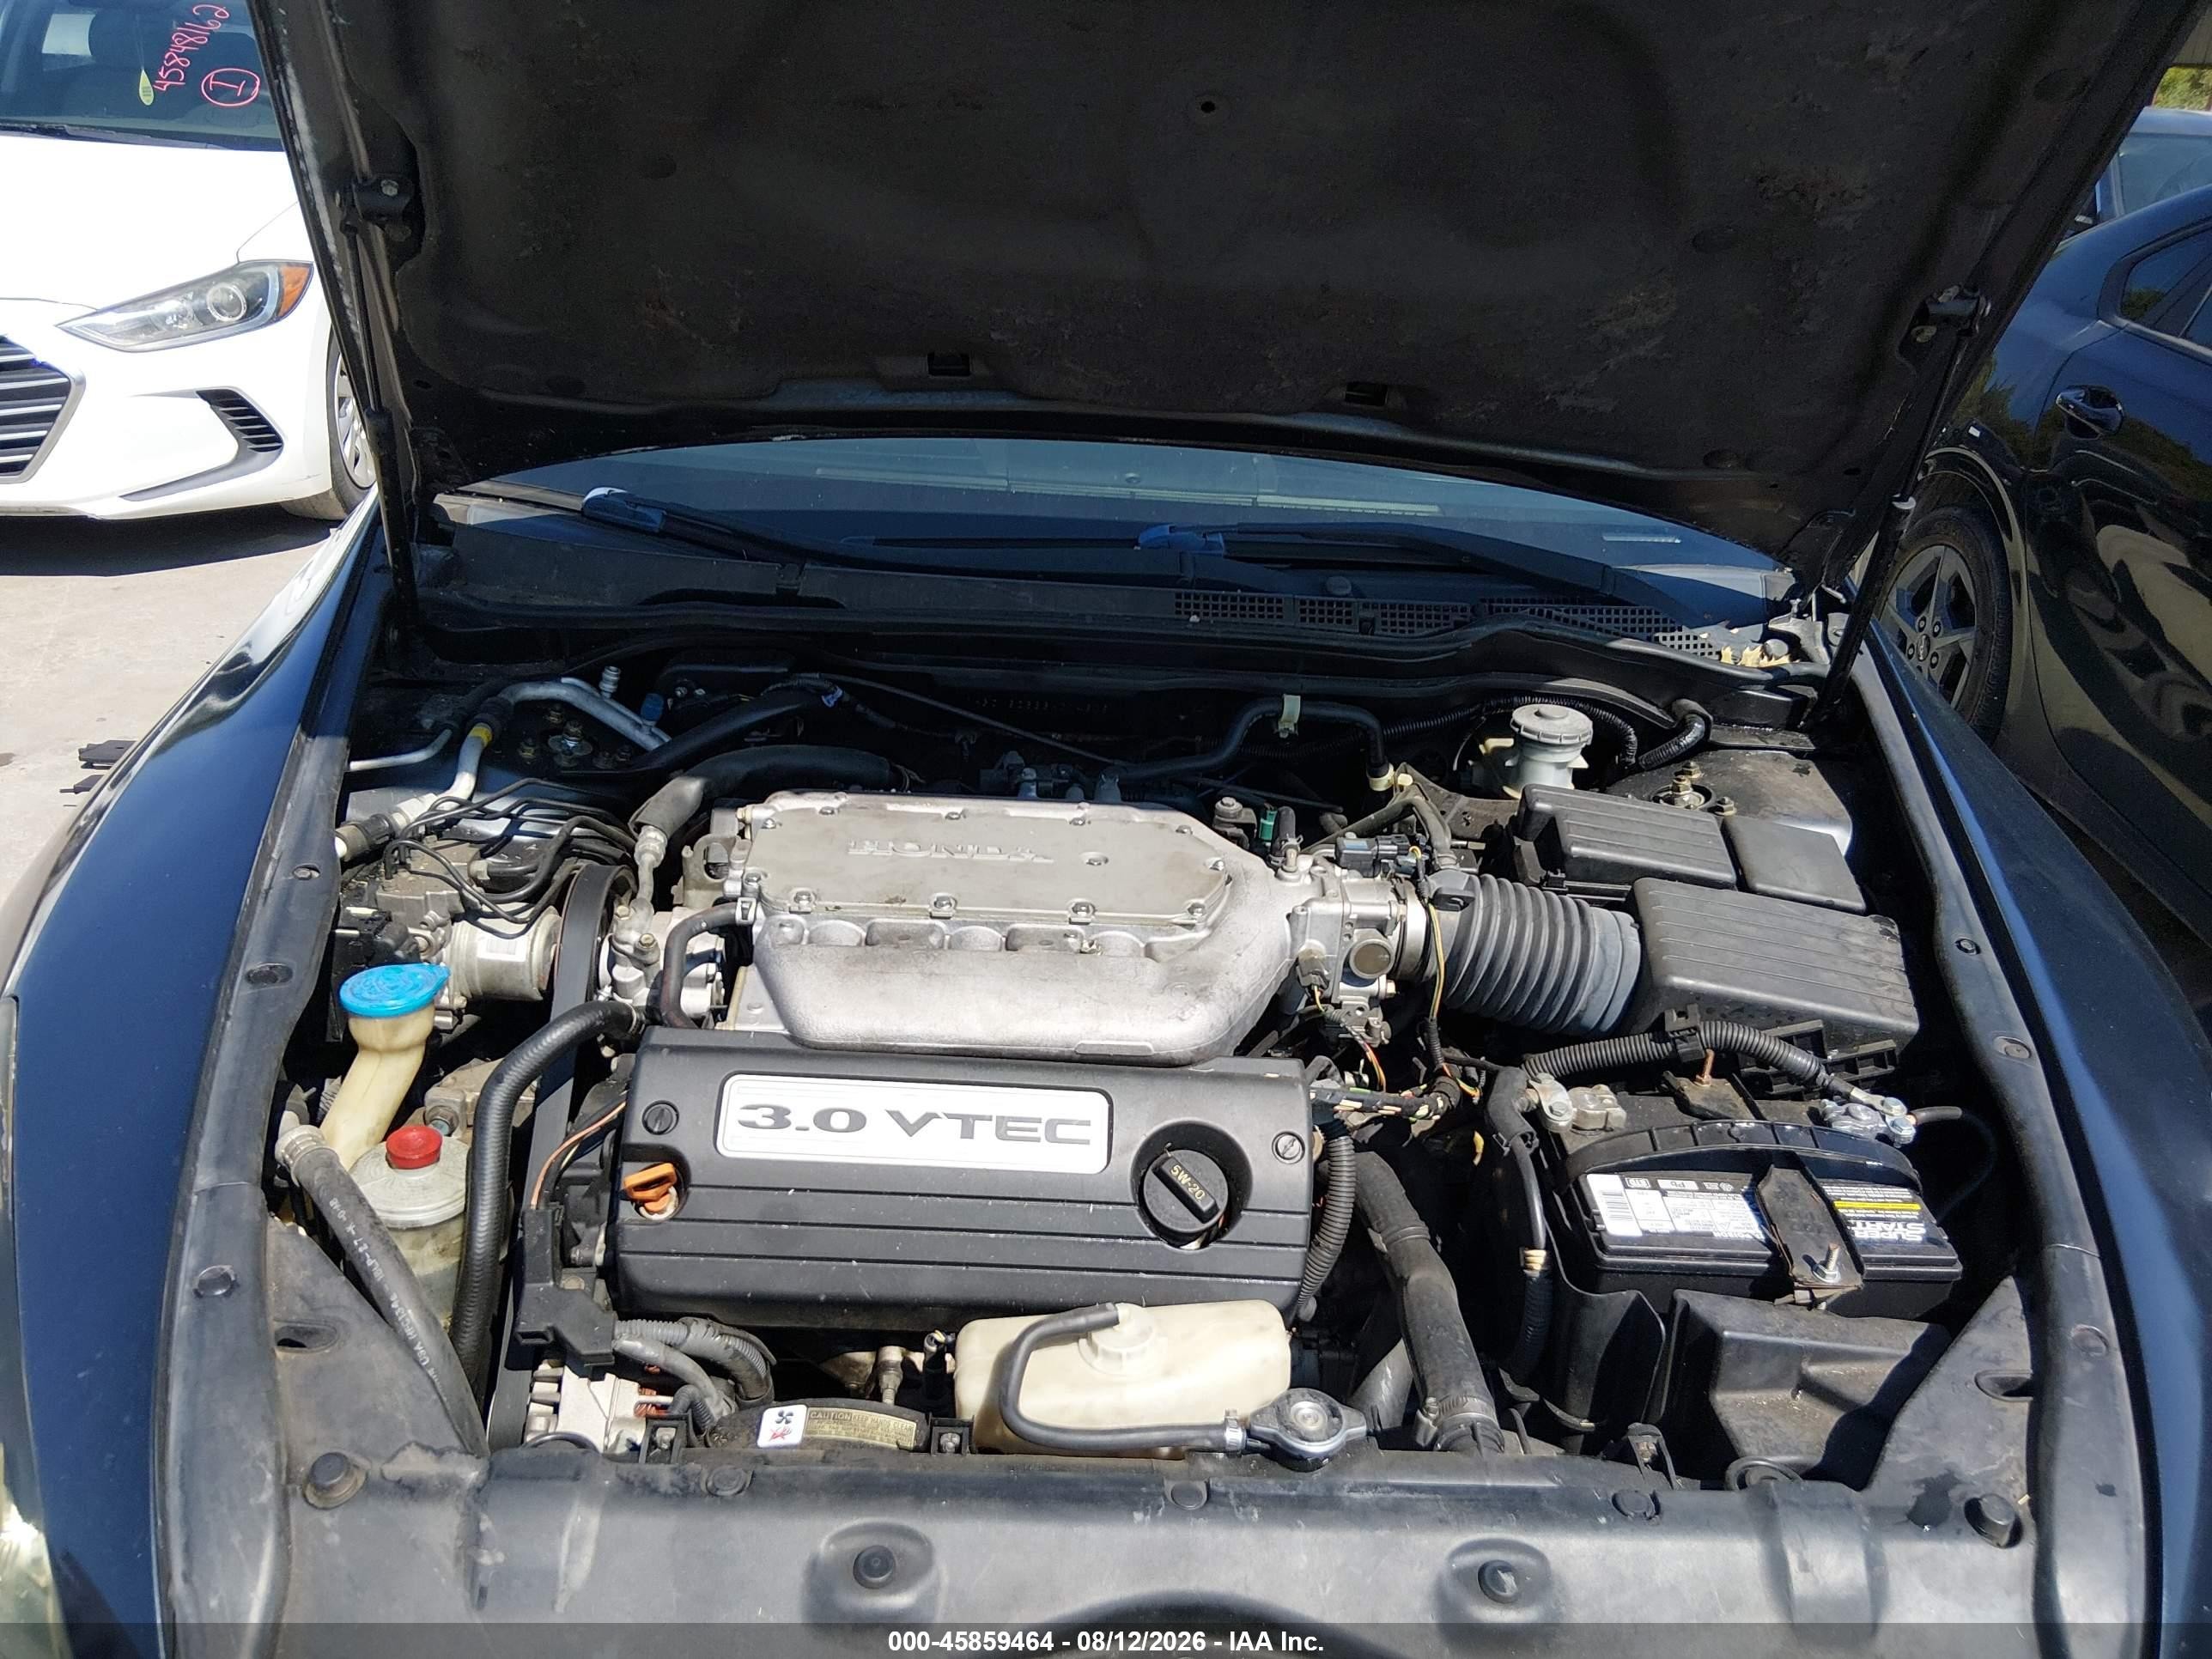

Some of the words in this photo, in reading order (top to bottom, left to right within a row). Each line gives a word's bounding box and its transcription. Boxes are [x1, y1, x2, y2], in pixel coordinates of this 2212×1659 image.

[848, 840, 1054, 863] HONDA
[737, 1103, 867, 1133] 3.0
[884, 1109, 1091, 1146] VTEC
[1170, 1164, 1206, 1200] 5W-20
[1850, 1220, 1926, 1235] START
[1853, 1229, 1923, 1242] SUPER
[810, 1410, 852, 1422] CAUTION
